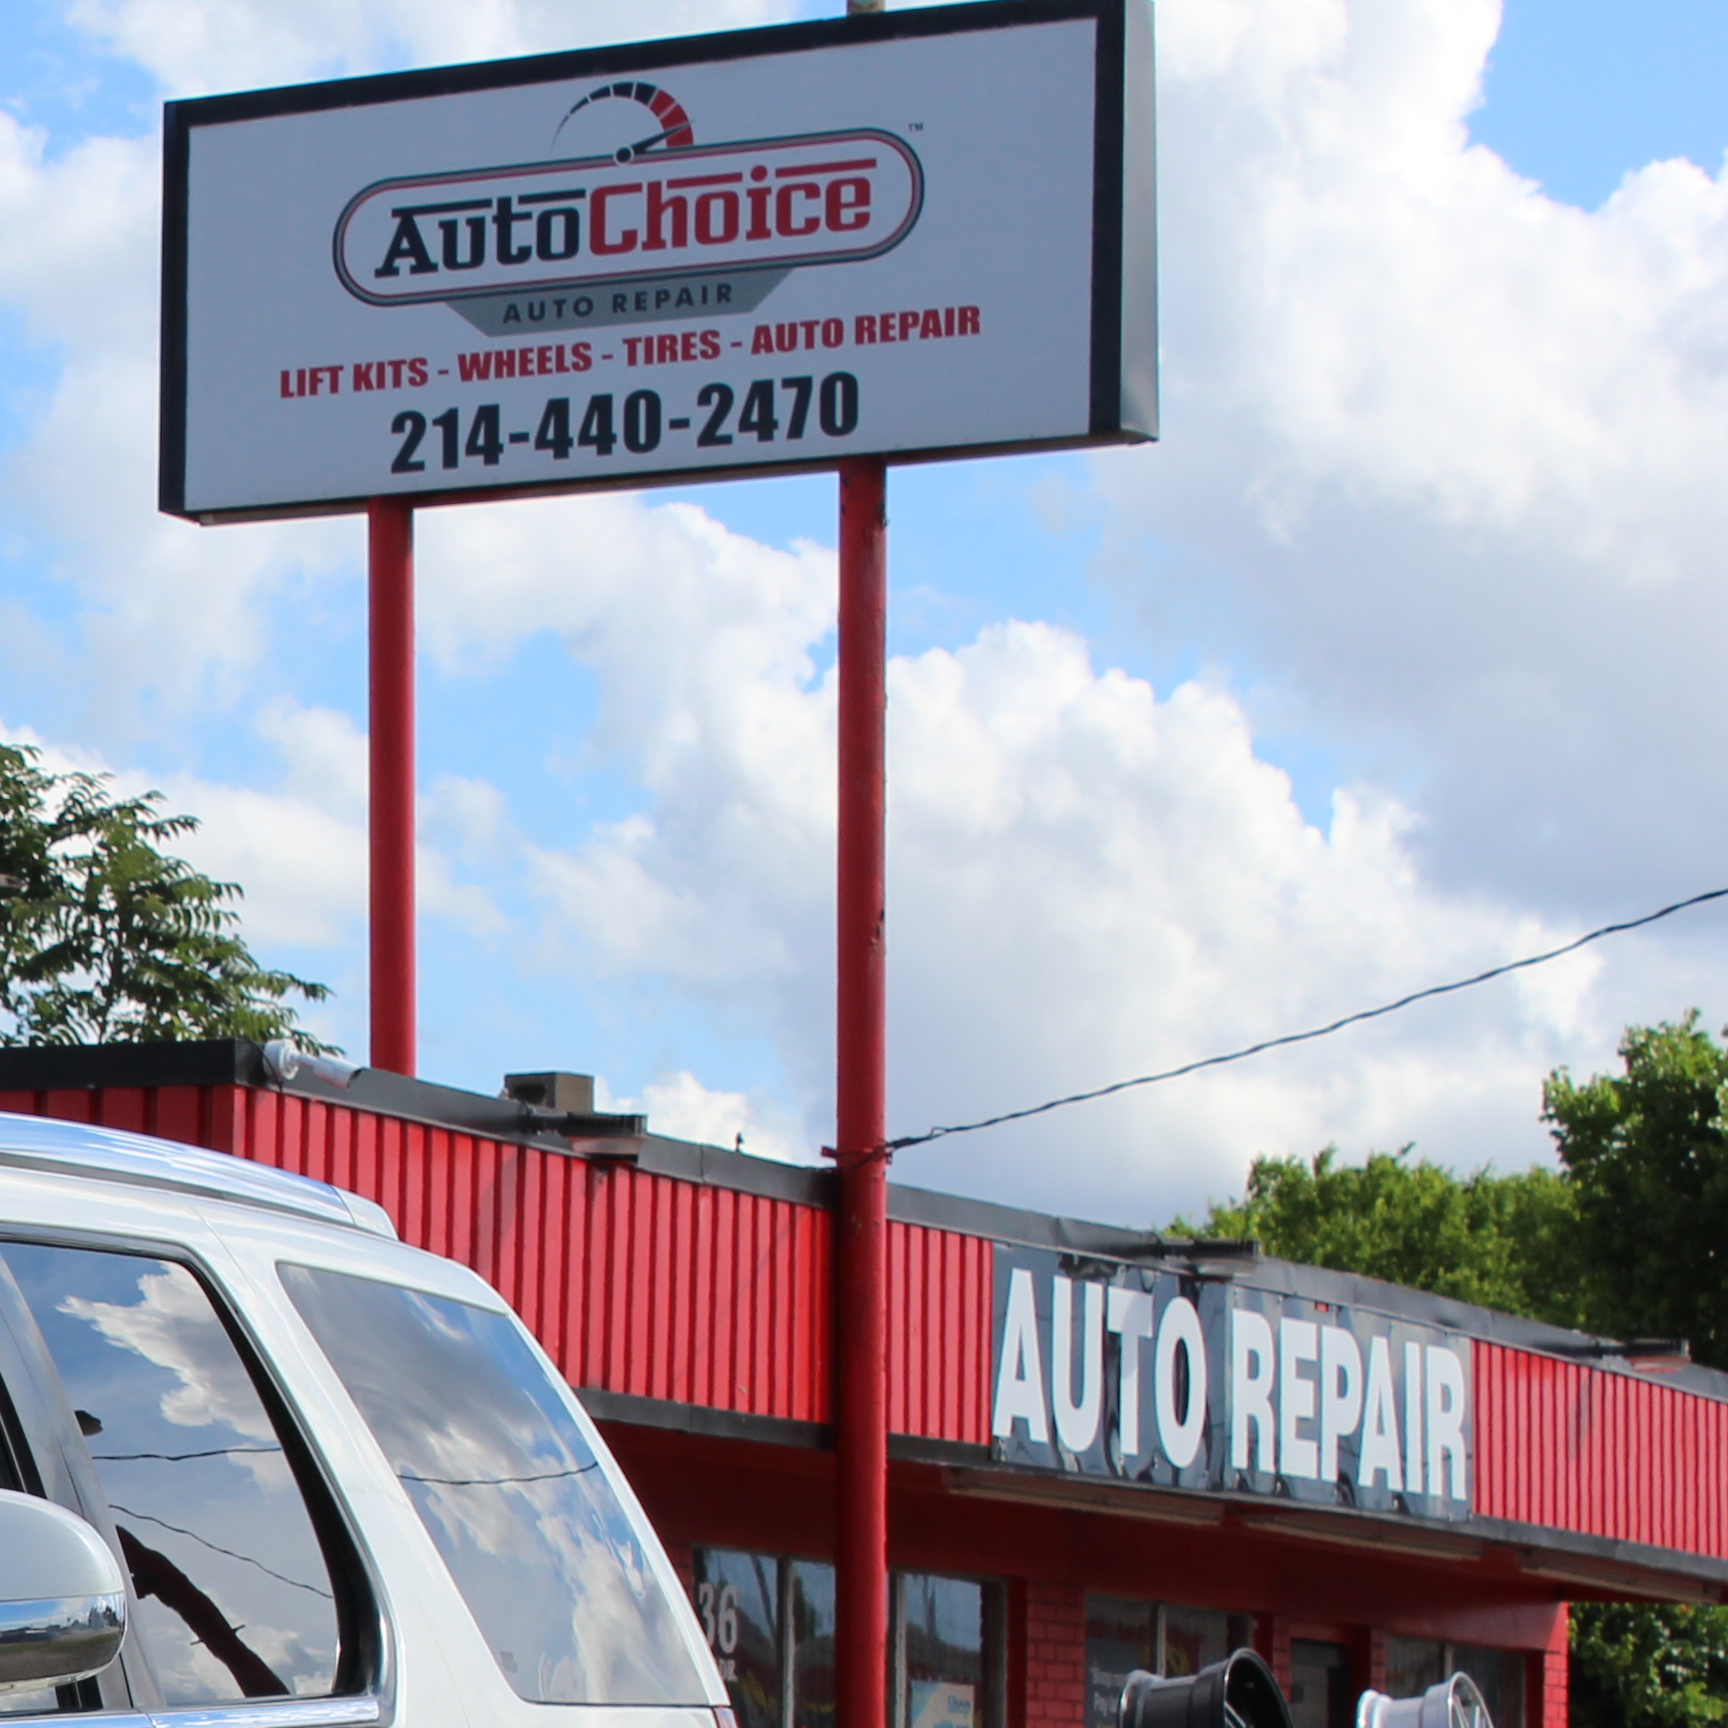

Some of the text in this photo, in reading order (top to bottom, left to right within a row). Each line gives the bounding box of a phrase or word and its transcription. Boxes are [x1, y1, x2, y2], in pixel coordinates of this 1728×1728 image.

[374, 158, 877, 279] AutoChoice
[279, 365, 344, 399] LIFT
[352, 357, 429, 392] KITS
[457, 342, 593, 383] WHEELS
[621, 329, 721, 367] TIRES
[750, 317, 845, 356] AUTO
[854, 304, 981, 346] REPAIR
[502, 283, 733, 324] AUTO REPAIR
[390, 370, 859, 475] 214-440-2470
[992, 1268, 1467, 1504] AUTO REPAIR
[947, 1694, 972, 1718] Shop
